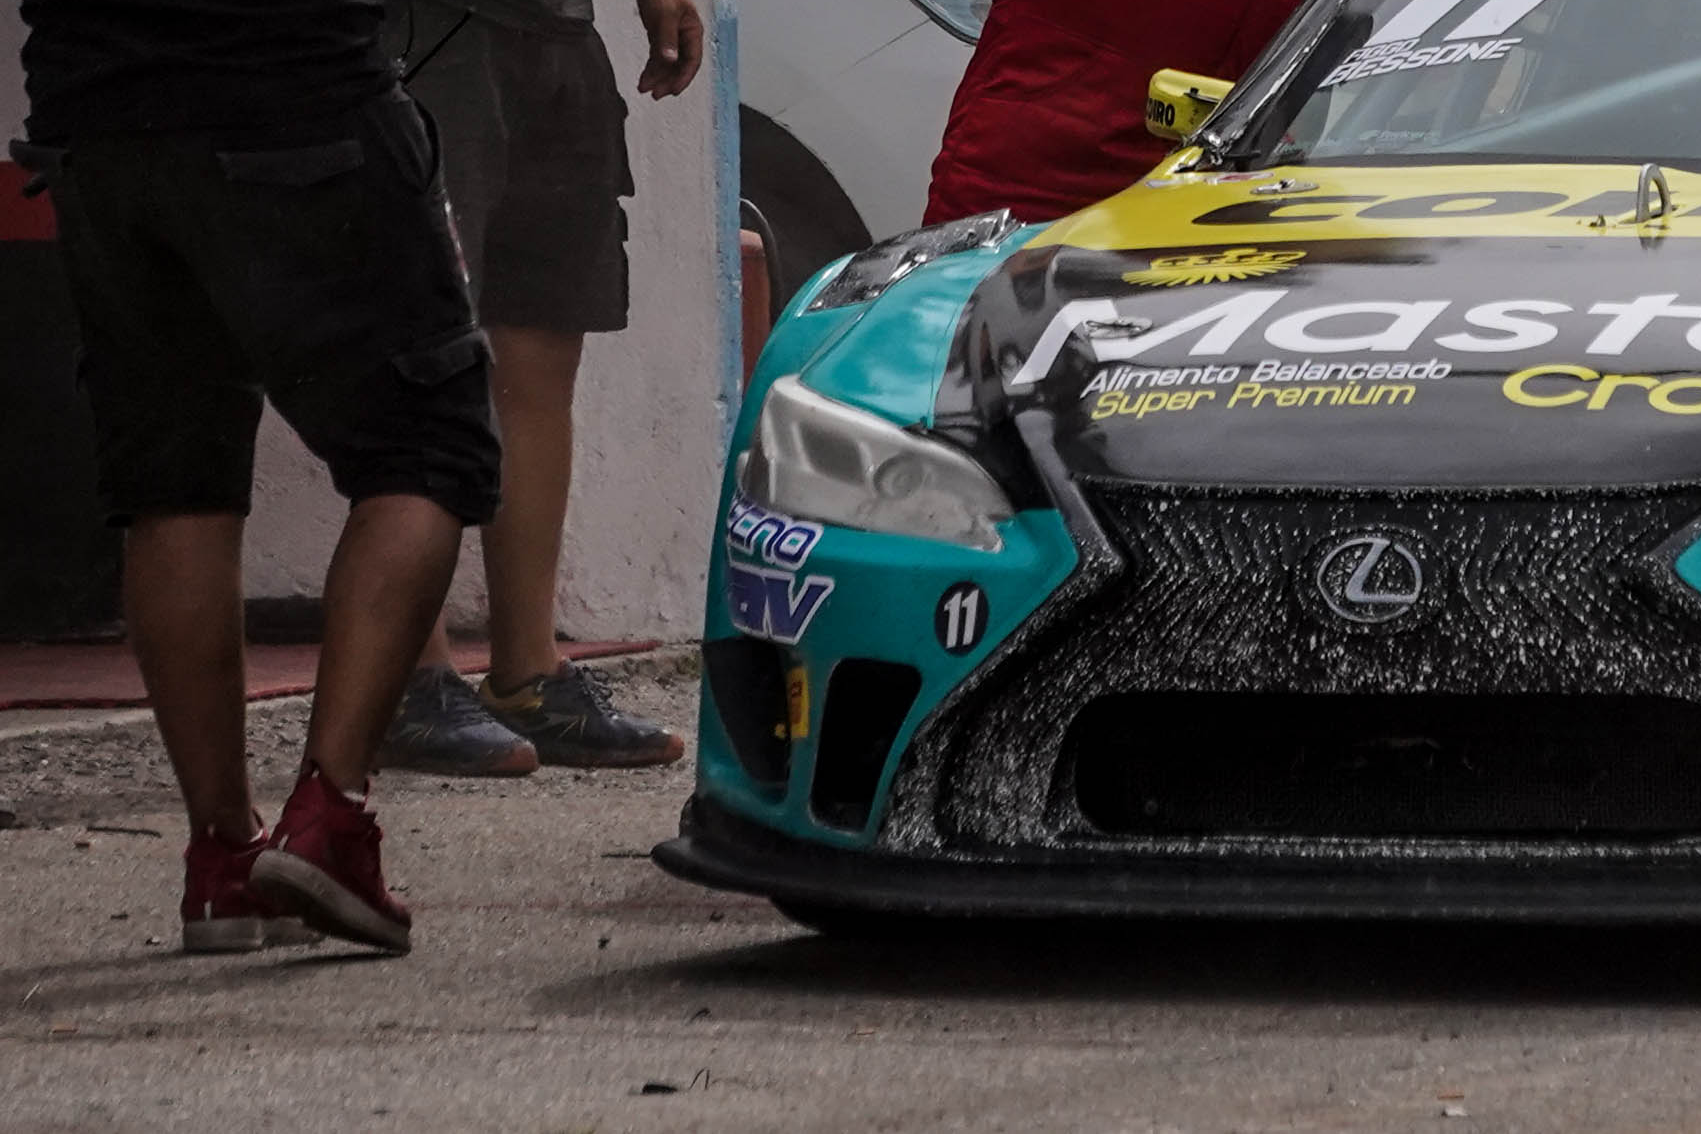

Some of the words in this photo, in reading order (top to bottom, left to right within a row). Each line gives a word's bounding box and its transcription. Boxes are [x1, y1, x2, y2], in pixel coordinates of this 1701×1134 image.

[1318, 37, 1524, 89] BESSONE
[1079, 364, 1241, 399] Alimento
[1249, 357, 1453, 384] Balanceado
[1090, 389, 1216, 420] Super
[1226, 380, 1417, 409] Premium
[943, 588, 980, 650] 11
